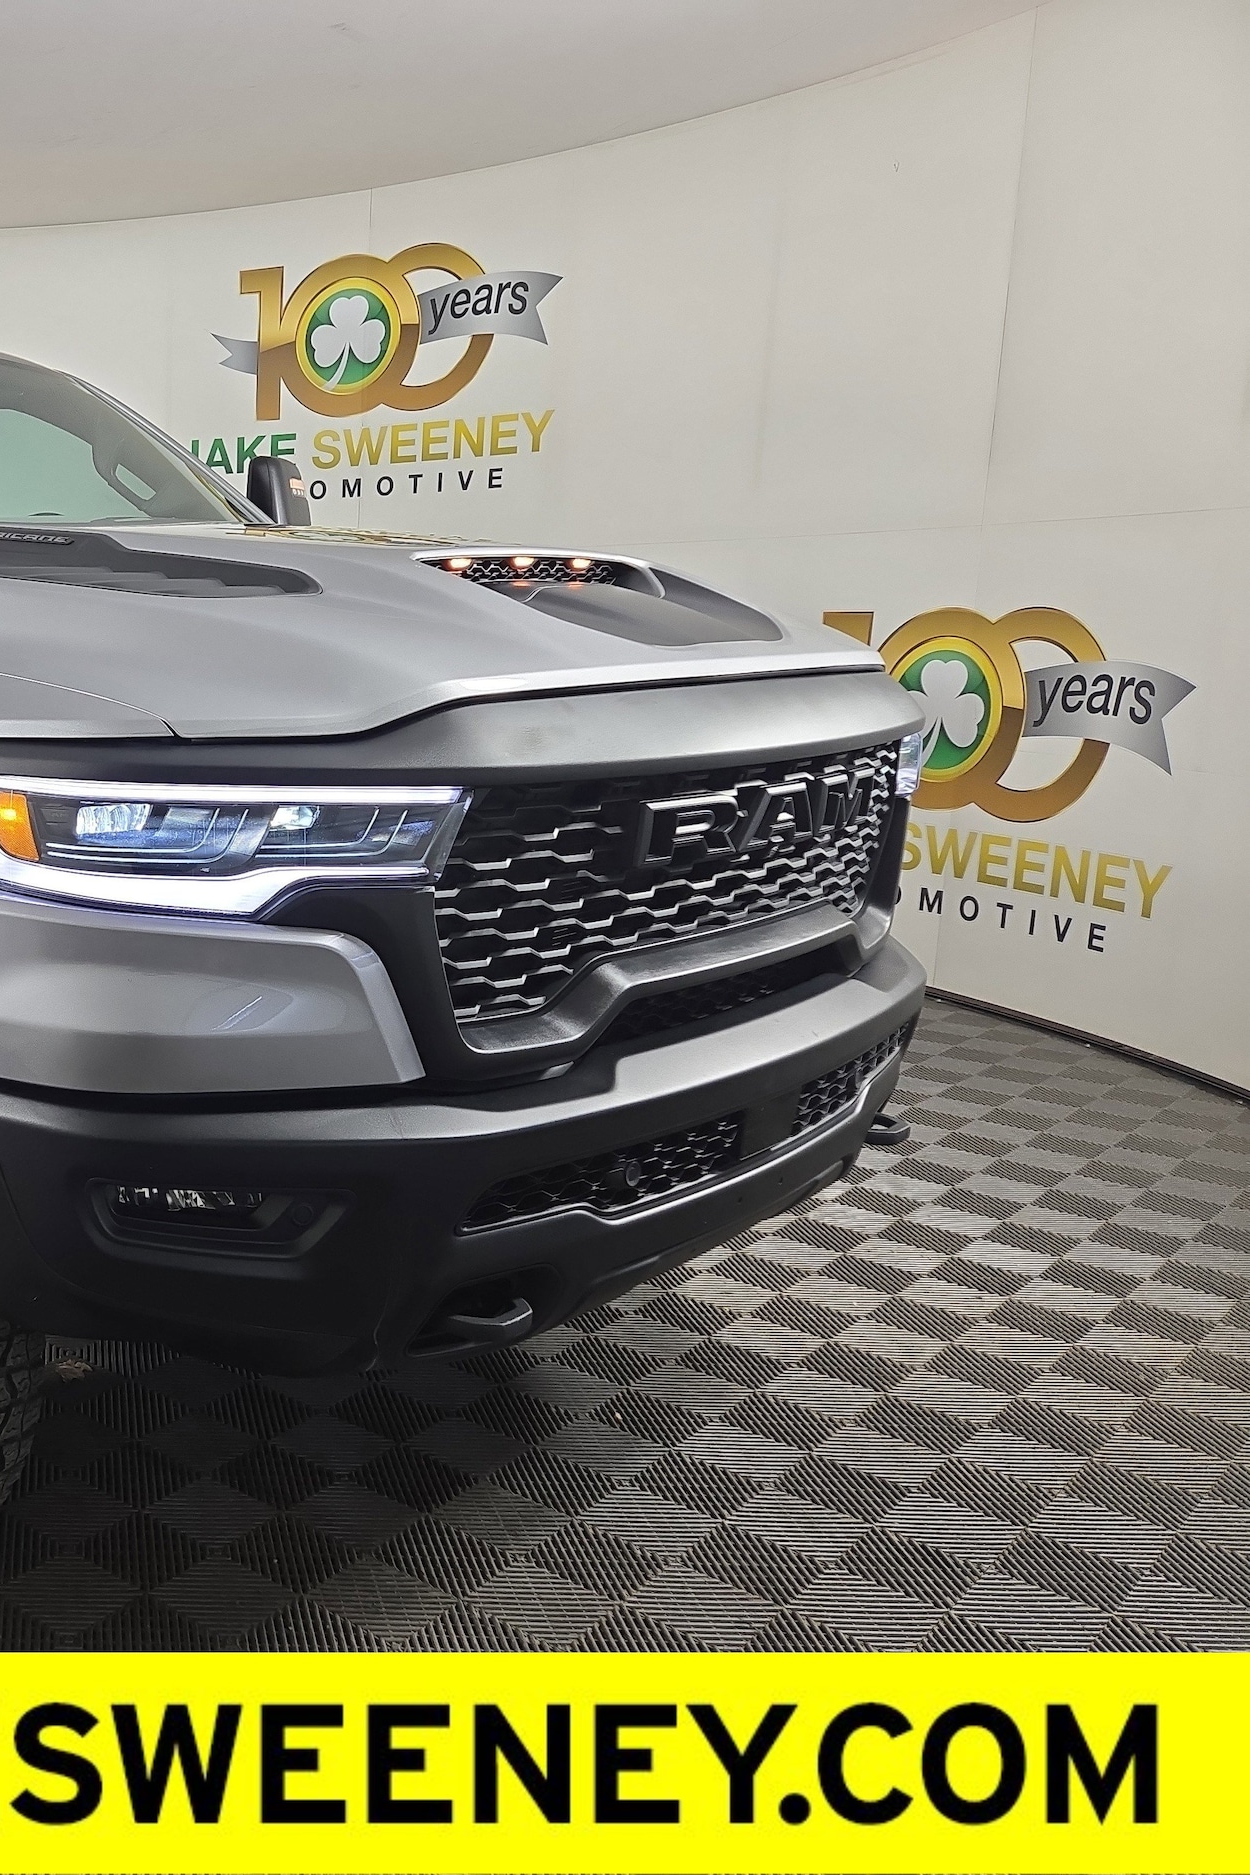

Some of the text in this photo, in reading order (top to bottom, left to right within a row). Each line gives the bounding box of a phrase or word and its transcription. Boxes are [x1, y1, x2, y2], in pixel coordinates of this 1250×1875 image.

[429, 276, 530, 336] years
[312, 410, 555, 470] SWEENEY
[309, 468, 504, 500] OMOTIVE
[1033, 673, 1156, 728] years
[638, 767, 875, 865] RAM
